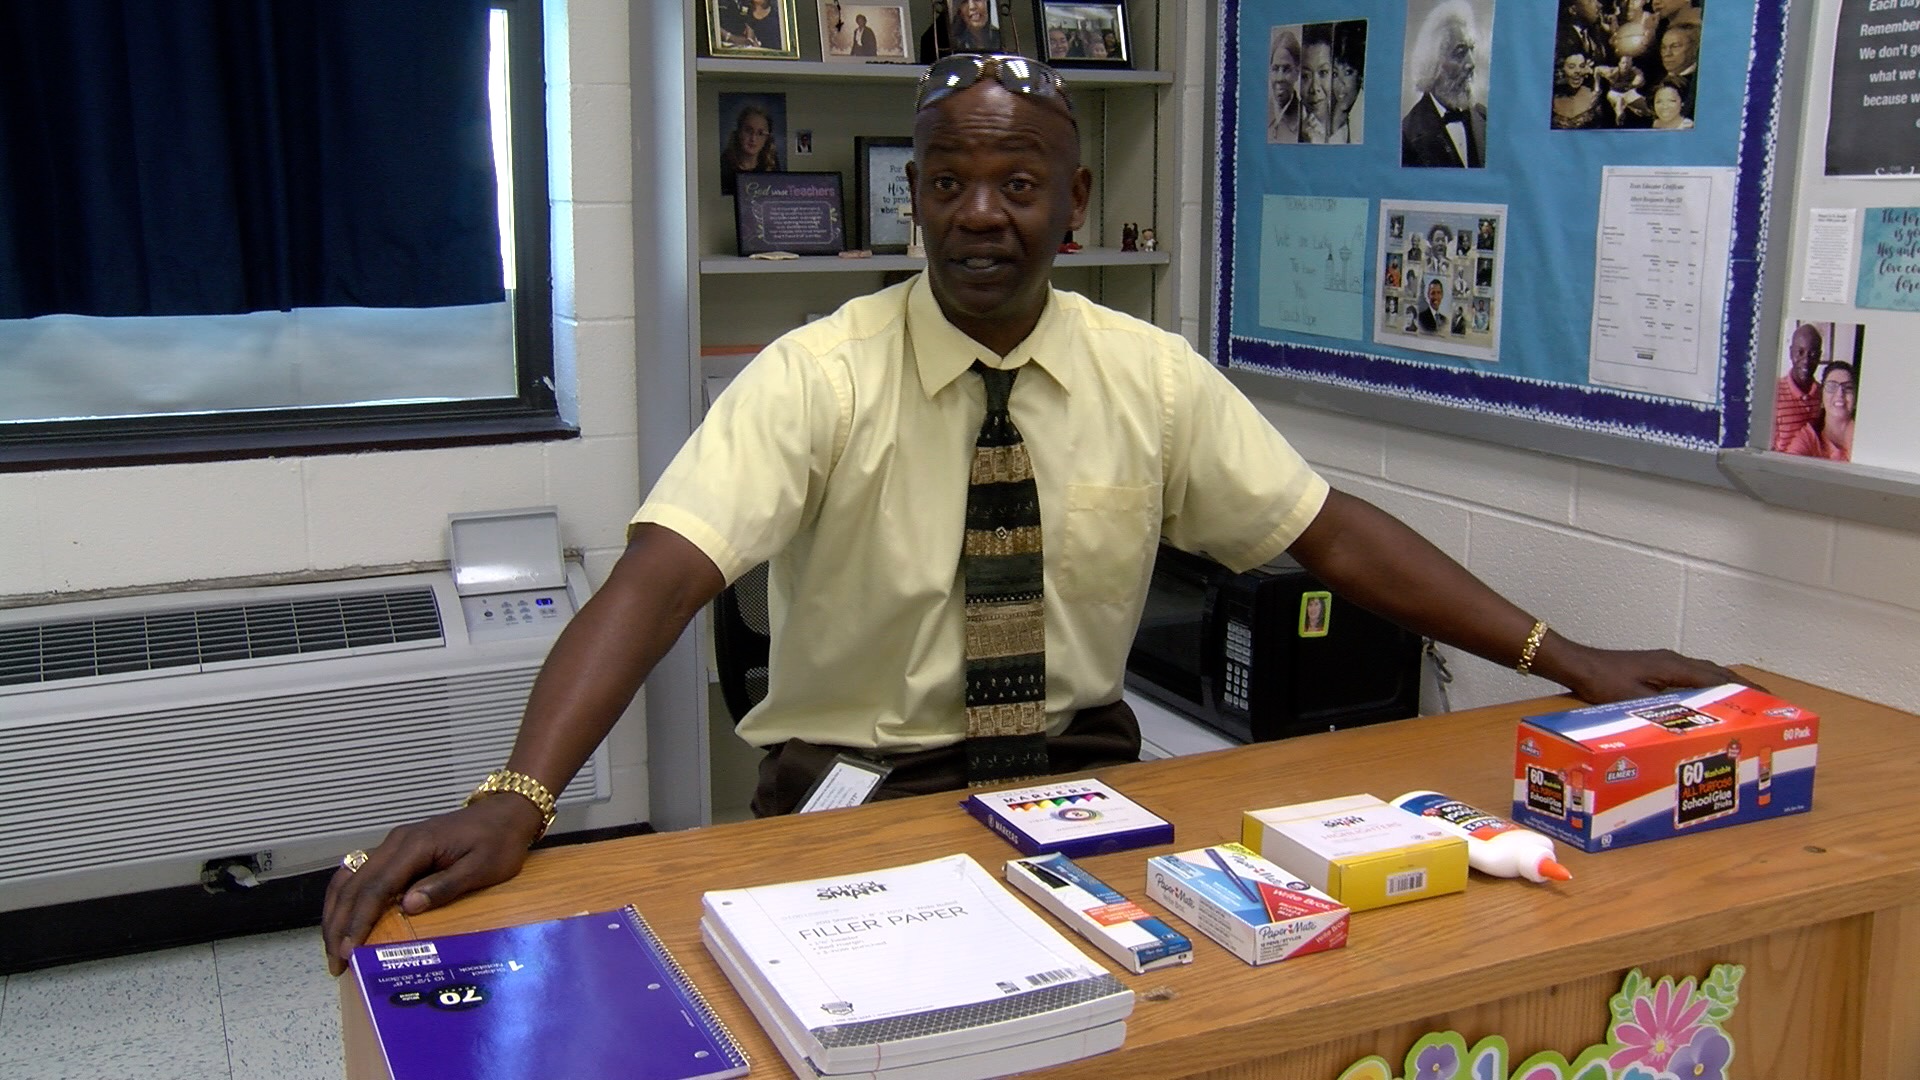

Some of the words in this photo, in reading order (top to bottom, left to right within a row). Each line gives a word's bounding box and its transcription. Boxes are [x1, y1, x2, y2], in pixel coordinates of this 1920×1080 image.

[1860, 20, 1920, 37] Remember
[1859, 48, 1876, 60] We
[1879, 45, 1907, 58] don't
[1869, 70, 1896, 83] what
[1899, 71, 1916, 80] we
[1863, 93, 1908, 107] because
[788, 184, 836, 197] Teachers
[888, 182, 905, 196] His
[1530, 769, 1544, 786] 60
[1607, 768, 1638, 781] ELMER'S
[1682, 762, 1703, 786] 60
[1704, 766, 1732, 778] Washable
[1002, 787, 1092, 803] MARKERS
[1682, 785, 1697, 798] ALL
[1699, 778, 1733, 794] PURPOSE
[1530, 792, 1549, 803] School
[1549, 797, 1562, 808] Glue
[1682, 795, 1712, 811] School
[1712, 790, 1733, 803] Glue
[995, 820, 1019, 846] MARKERS
[816, 881, 881, 893] SCHOOL
[816, 884, 889, 901] SMART
[1154, 872, 1176, 897] Paper
[1178, 888, 1196, 910] Mate
[1273, 889, 1303, 904] Write
[798, 919, 883, 941] FILLER
[888, 905, 969, 926] PAPER
[1259, 925, 1287, 941] Paper
[1293, 921, 1317, 934] Mate
[507, 960, 525, 972] 1
[438, 988, 483, 1006] 70
